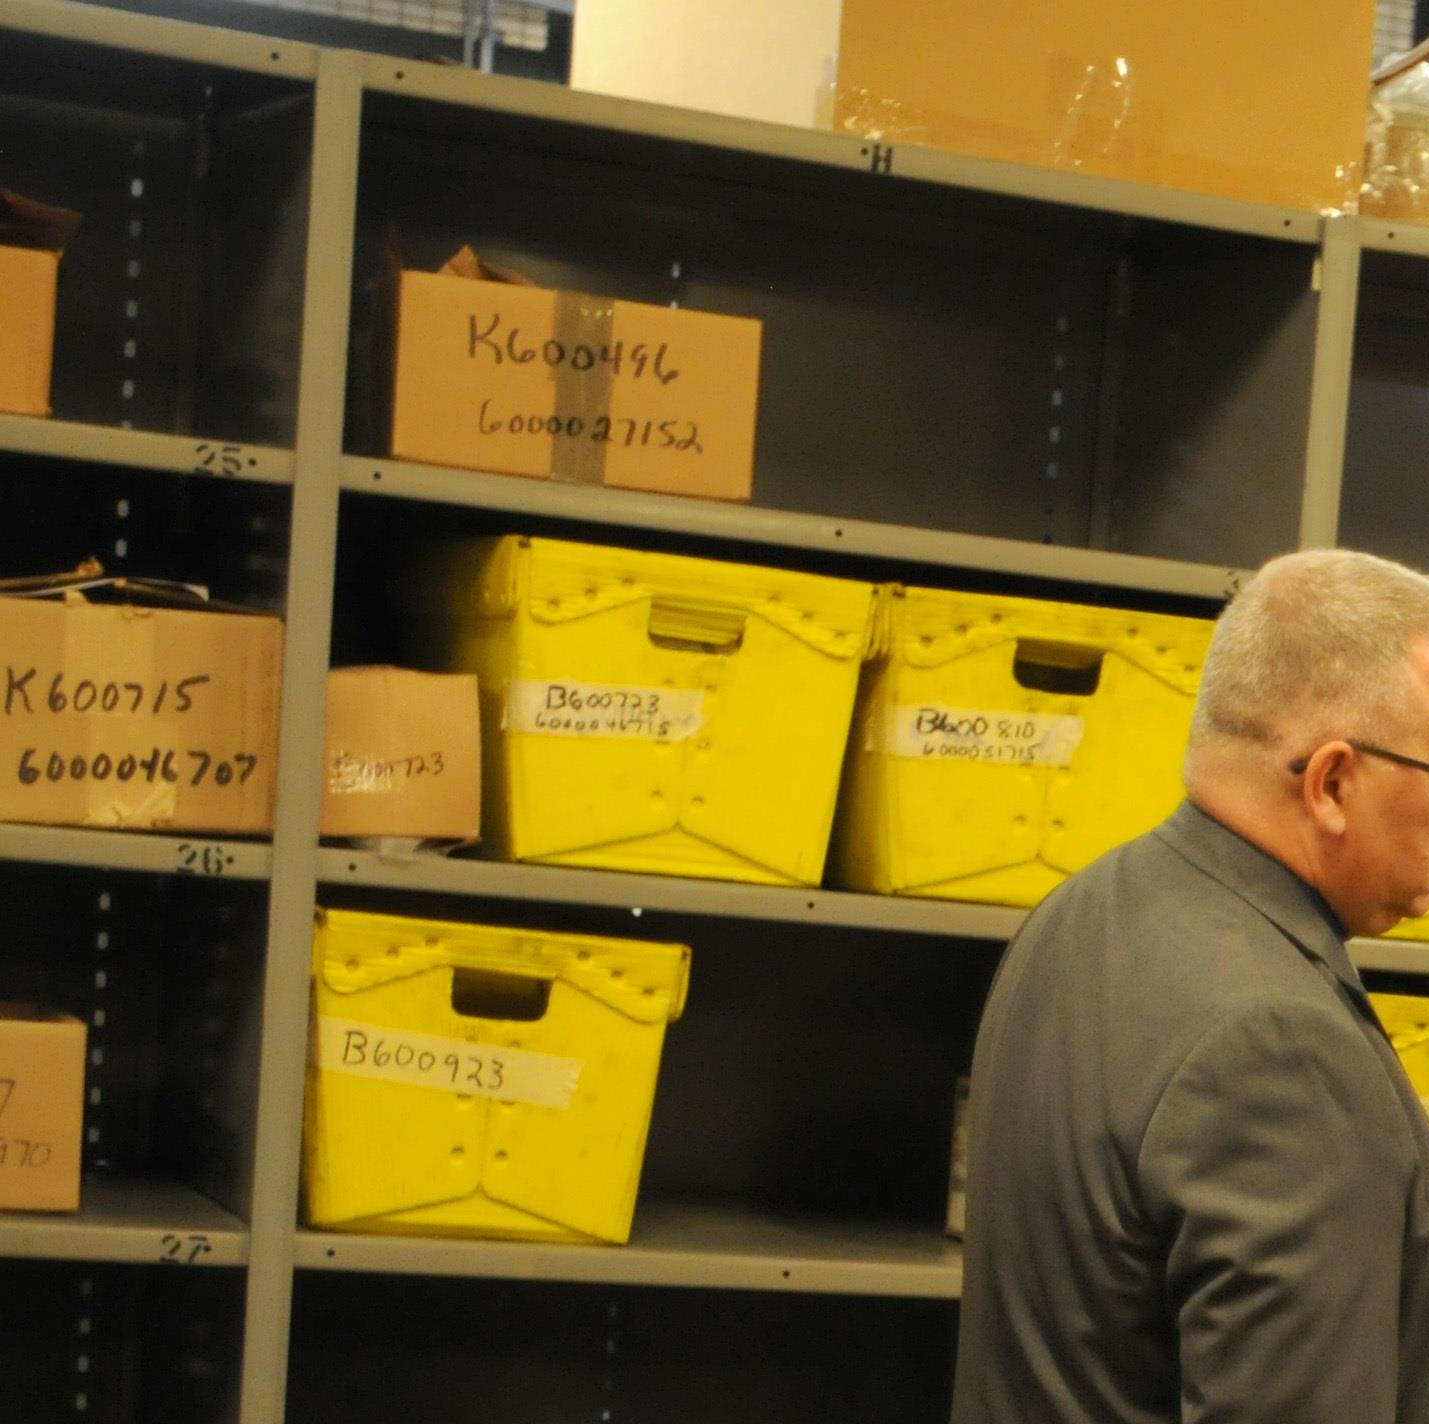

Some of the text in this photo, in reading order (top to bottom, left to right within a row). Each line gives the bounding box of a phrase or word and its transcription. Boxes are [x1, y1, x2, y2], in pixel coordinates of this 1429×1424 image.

[468, 312, 681, 385] K600496
[479, 399, 704, 455] 6000027152
[3, 665, 211, 717] K600715
[545, 684, 661, 714] B600723
[17, 747, 258, 788] 6000046707
[341, 1029, 504, 1090] B600923
[159, 1233, 208, 1265] 27
